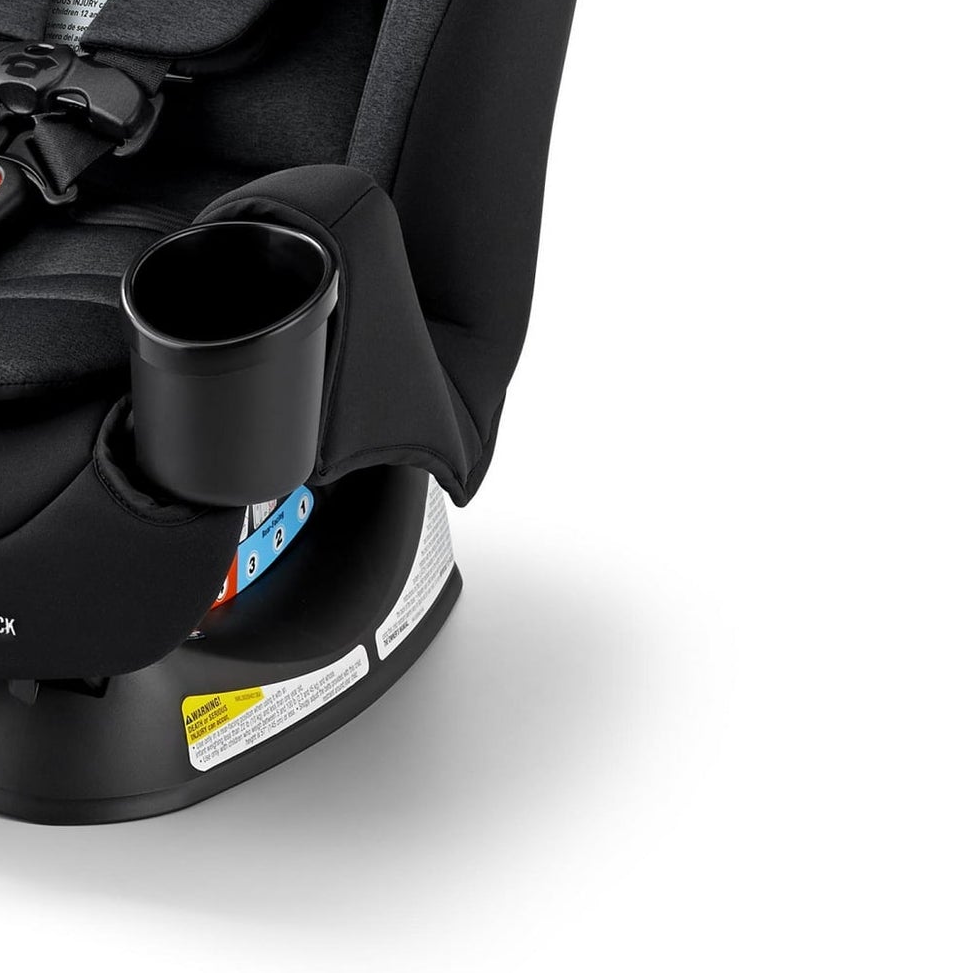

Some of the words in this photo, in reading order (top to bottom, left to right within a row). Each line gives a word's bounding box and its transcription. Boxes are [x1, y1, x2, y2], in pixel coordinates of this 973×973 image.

[81, 10, 89, 18] 12
[300, 499, 307, 515] 1
[275, 528, 283, 548] 2
[248, 556, 256, 574] 3
[191, 696, 222, 721] WARNING!
[187, 720, 203, 733] DEATH
[208, 705, 228, 721] SERIOUS
[190, 726, 207, 741] INJURY
